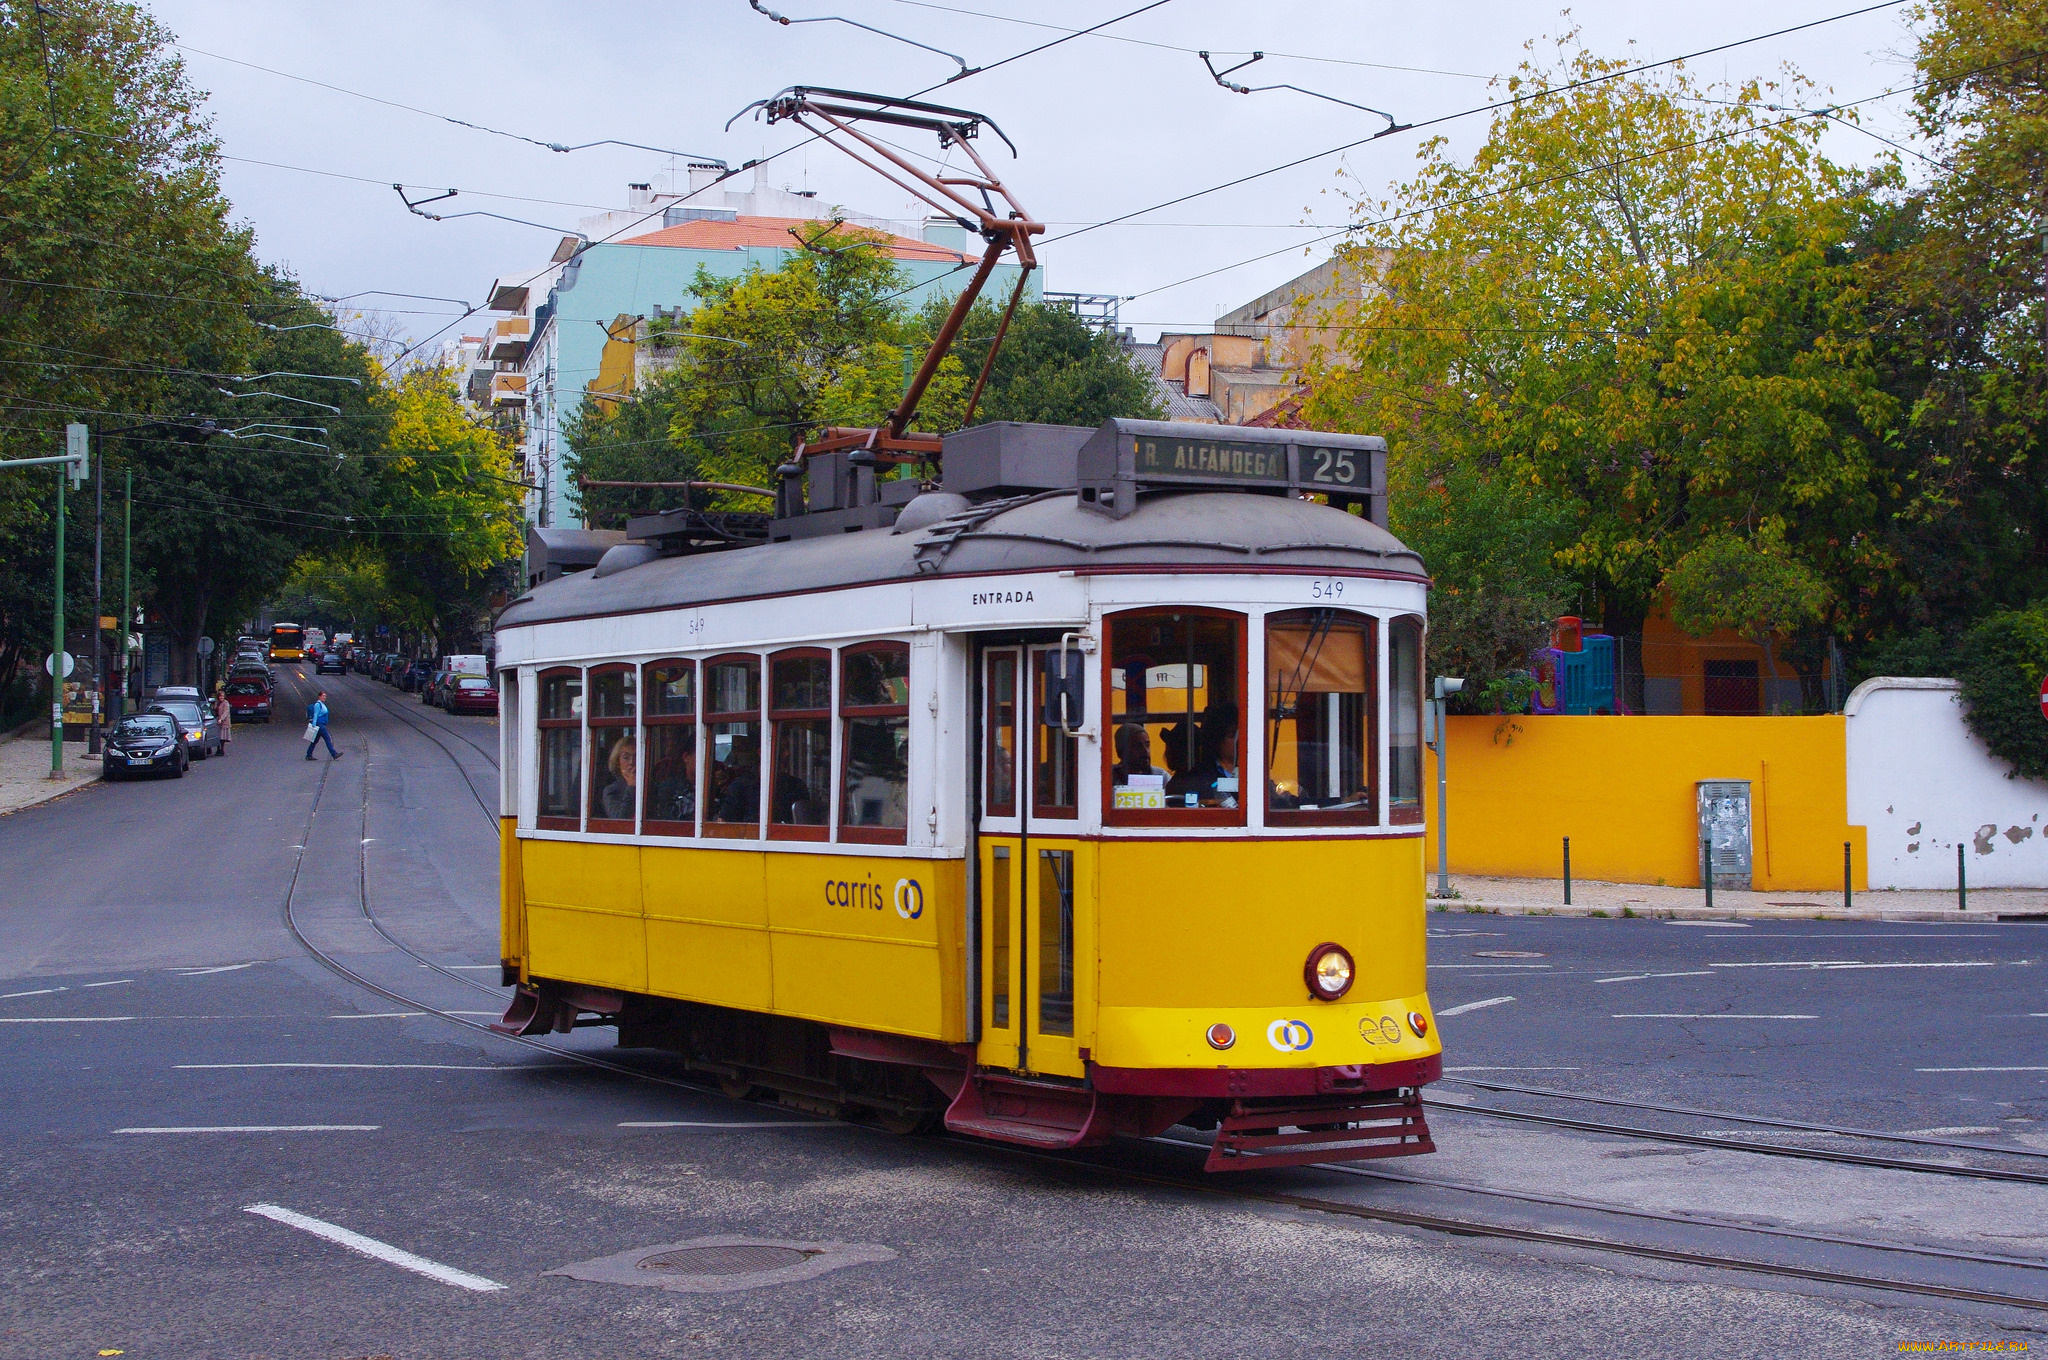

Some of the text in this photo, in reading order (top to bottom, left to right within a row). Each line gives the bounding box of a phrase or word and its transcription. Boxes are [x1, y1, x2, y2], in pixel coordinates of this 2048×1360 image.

[1313, 448, 1356, 483] 25
[972, 590, 1034, 606] ENTRADA
[1312, 581, 1344, 599] 549
[689, 618, 705, 635] 549
[1148, 794, 1158, 808] 6
[825, 871, 884, 911] carris
